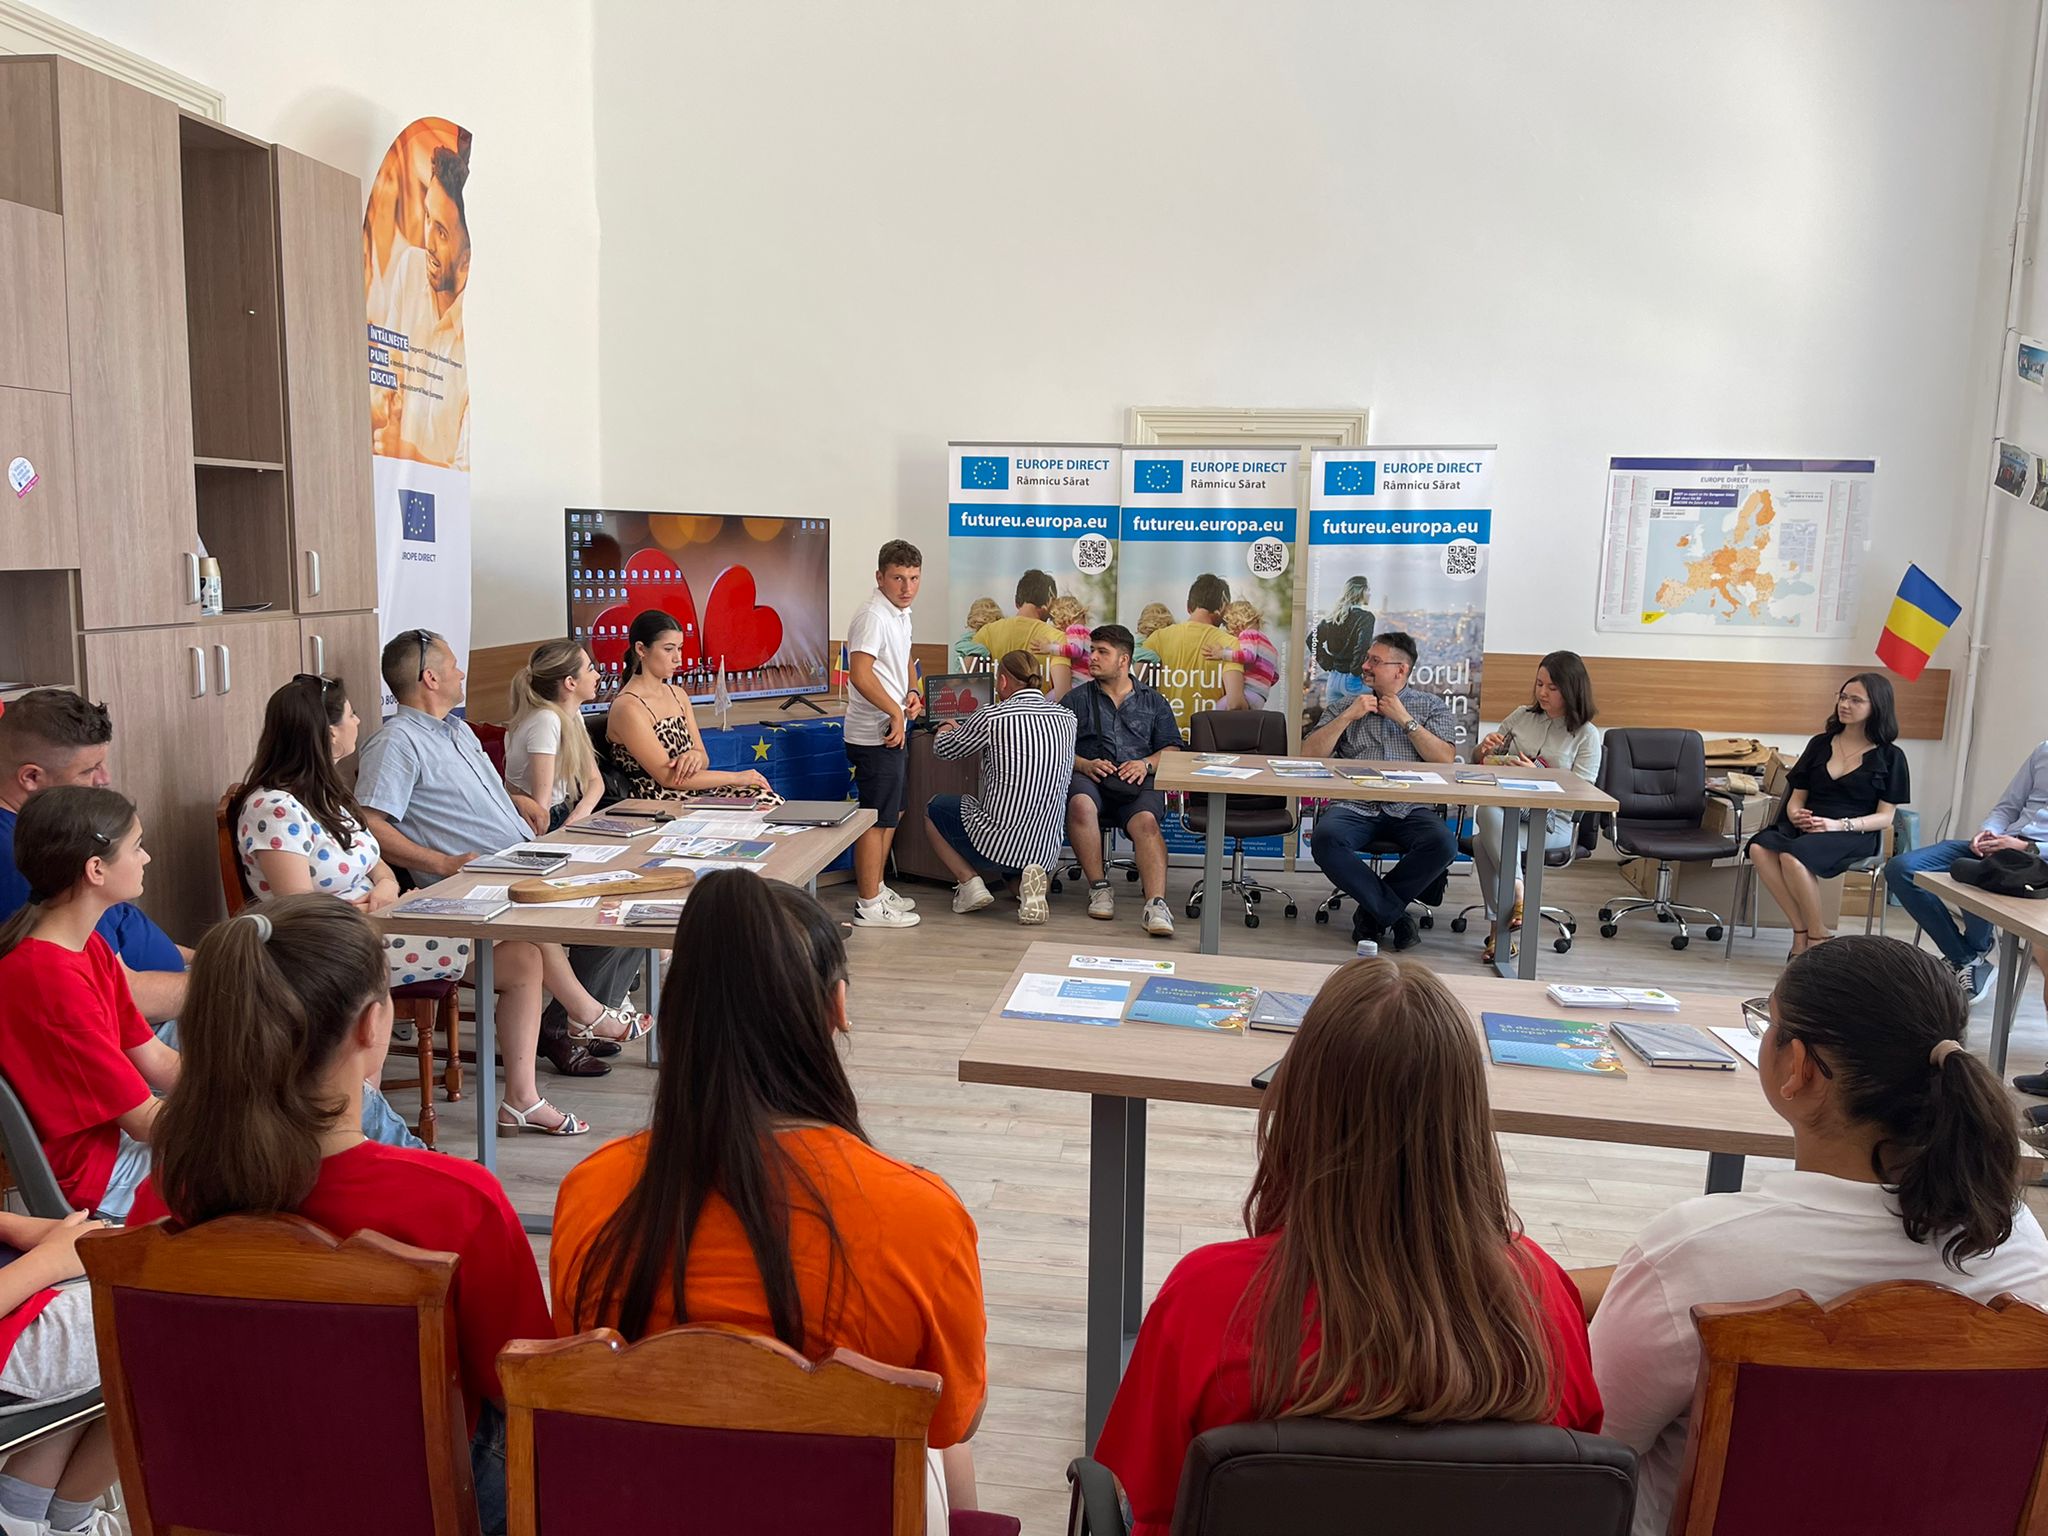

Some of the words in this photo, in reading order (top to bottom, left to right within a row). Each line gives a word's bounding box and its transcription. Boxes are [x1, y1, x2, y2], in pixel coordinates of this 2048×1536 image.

[370, 349, 389, 364] PUNE
[1016, 459, 1063, 470] EUROPE
[1066, 460, 1110, 471] DIRECT
[1190, 462, 1239, 473] EUROPE
[1242, 462, 1287, 473] DIRECT
[1383, 463, 1434, 474] EUROPE
[1437, 462, 1483, 473] DIRECT
[1016, 475, 1061, 486] Râmnicu
[1063, 476, 1090, 486] Sărat
[1190, 479, 1236, 489] Râmnicu
[1238, 479, 1266, 489] Sărat
[1383, 480, 1430, 490] Râmnicu
[1432, 480, 1461, 490] Sărat
[961, 512, 1108, 531] futureu.europa.eu
[1133, 516, 1284, 535] futureu.europa.eu
[1322, 519, 1478, 537] futureu.europa.eu
[959, 656, 1051, 682] Viitl
